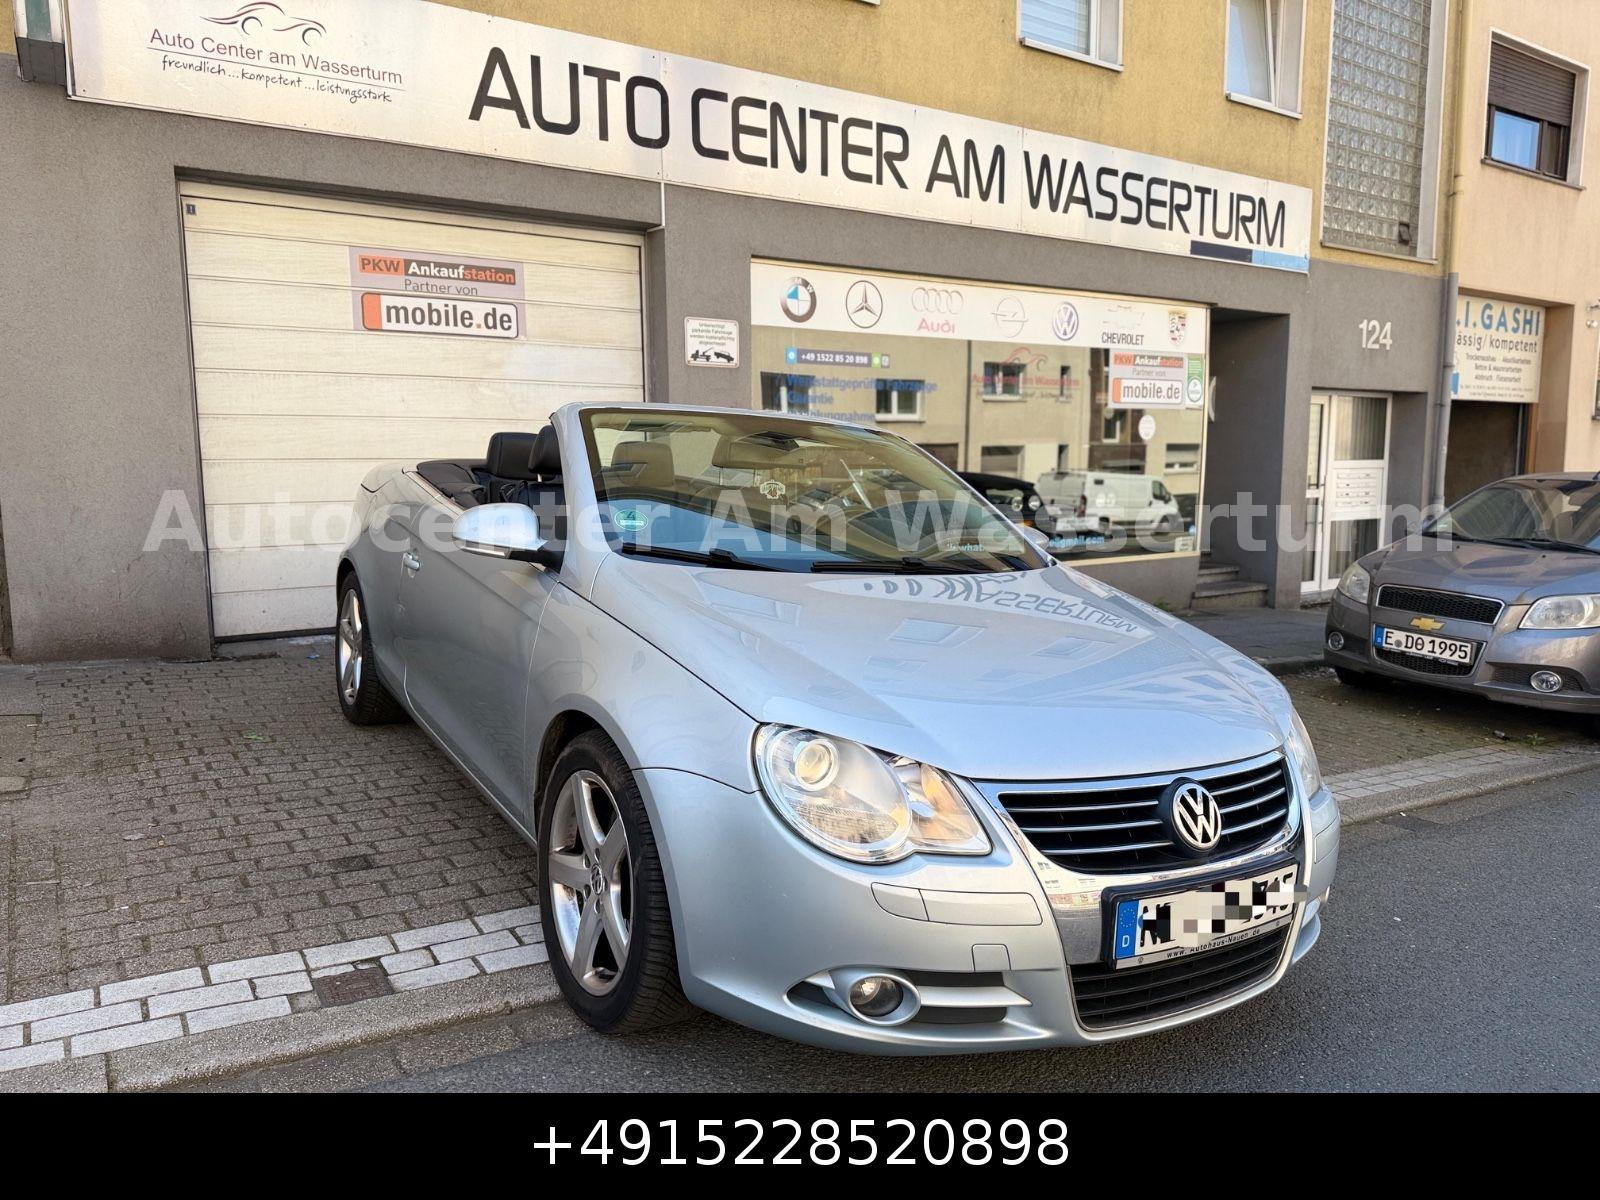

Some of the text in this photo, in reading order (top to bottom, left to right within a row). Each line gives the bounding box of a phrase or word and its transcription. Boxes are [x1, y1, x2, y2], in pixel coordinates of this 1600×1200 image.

[149, 28, 402, 84] Auto Center am Wasserturm
[468, 46, 1285, 248] AUTO CENTER AM WASSERTURM
[360, 257, 515, 284] PKW Ankaufstation
[404, 279, 478, 296] Partner von
[386, 302, 512, 331] mobile.de
[917, 318, 956, 334] Audi
[1101, 331, 1145, 346] CHEVROLET
[1359, 319, 1393, 351] 124
[1489, 334, 1537, 353] kompetent
[1122, 383, 1180, 400] mobile.de
[1384, 630, 1394, 646] E
[1427, 639, 1469, 660] 1995
[1121, 934, 1130, 948] D
